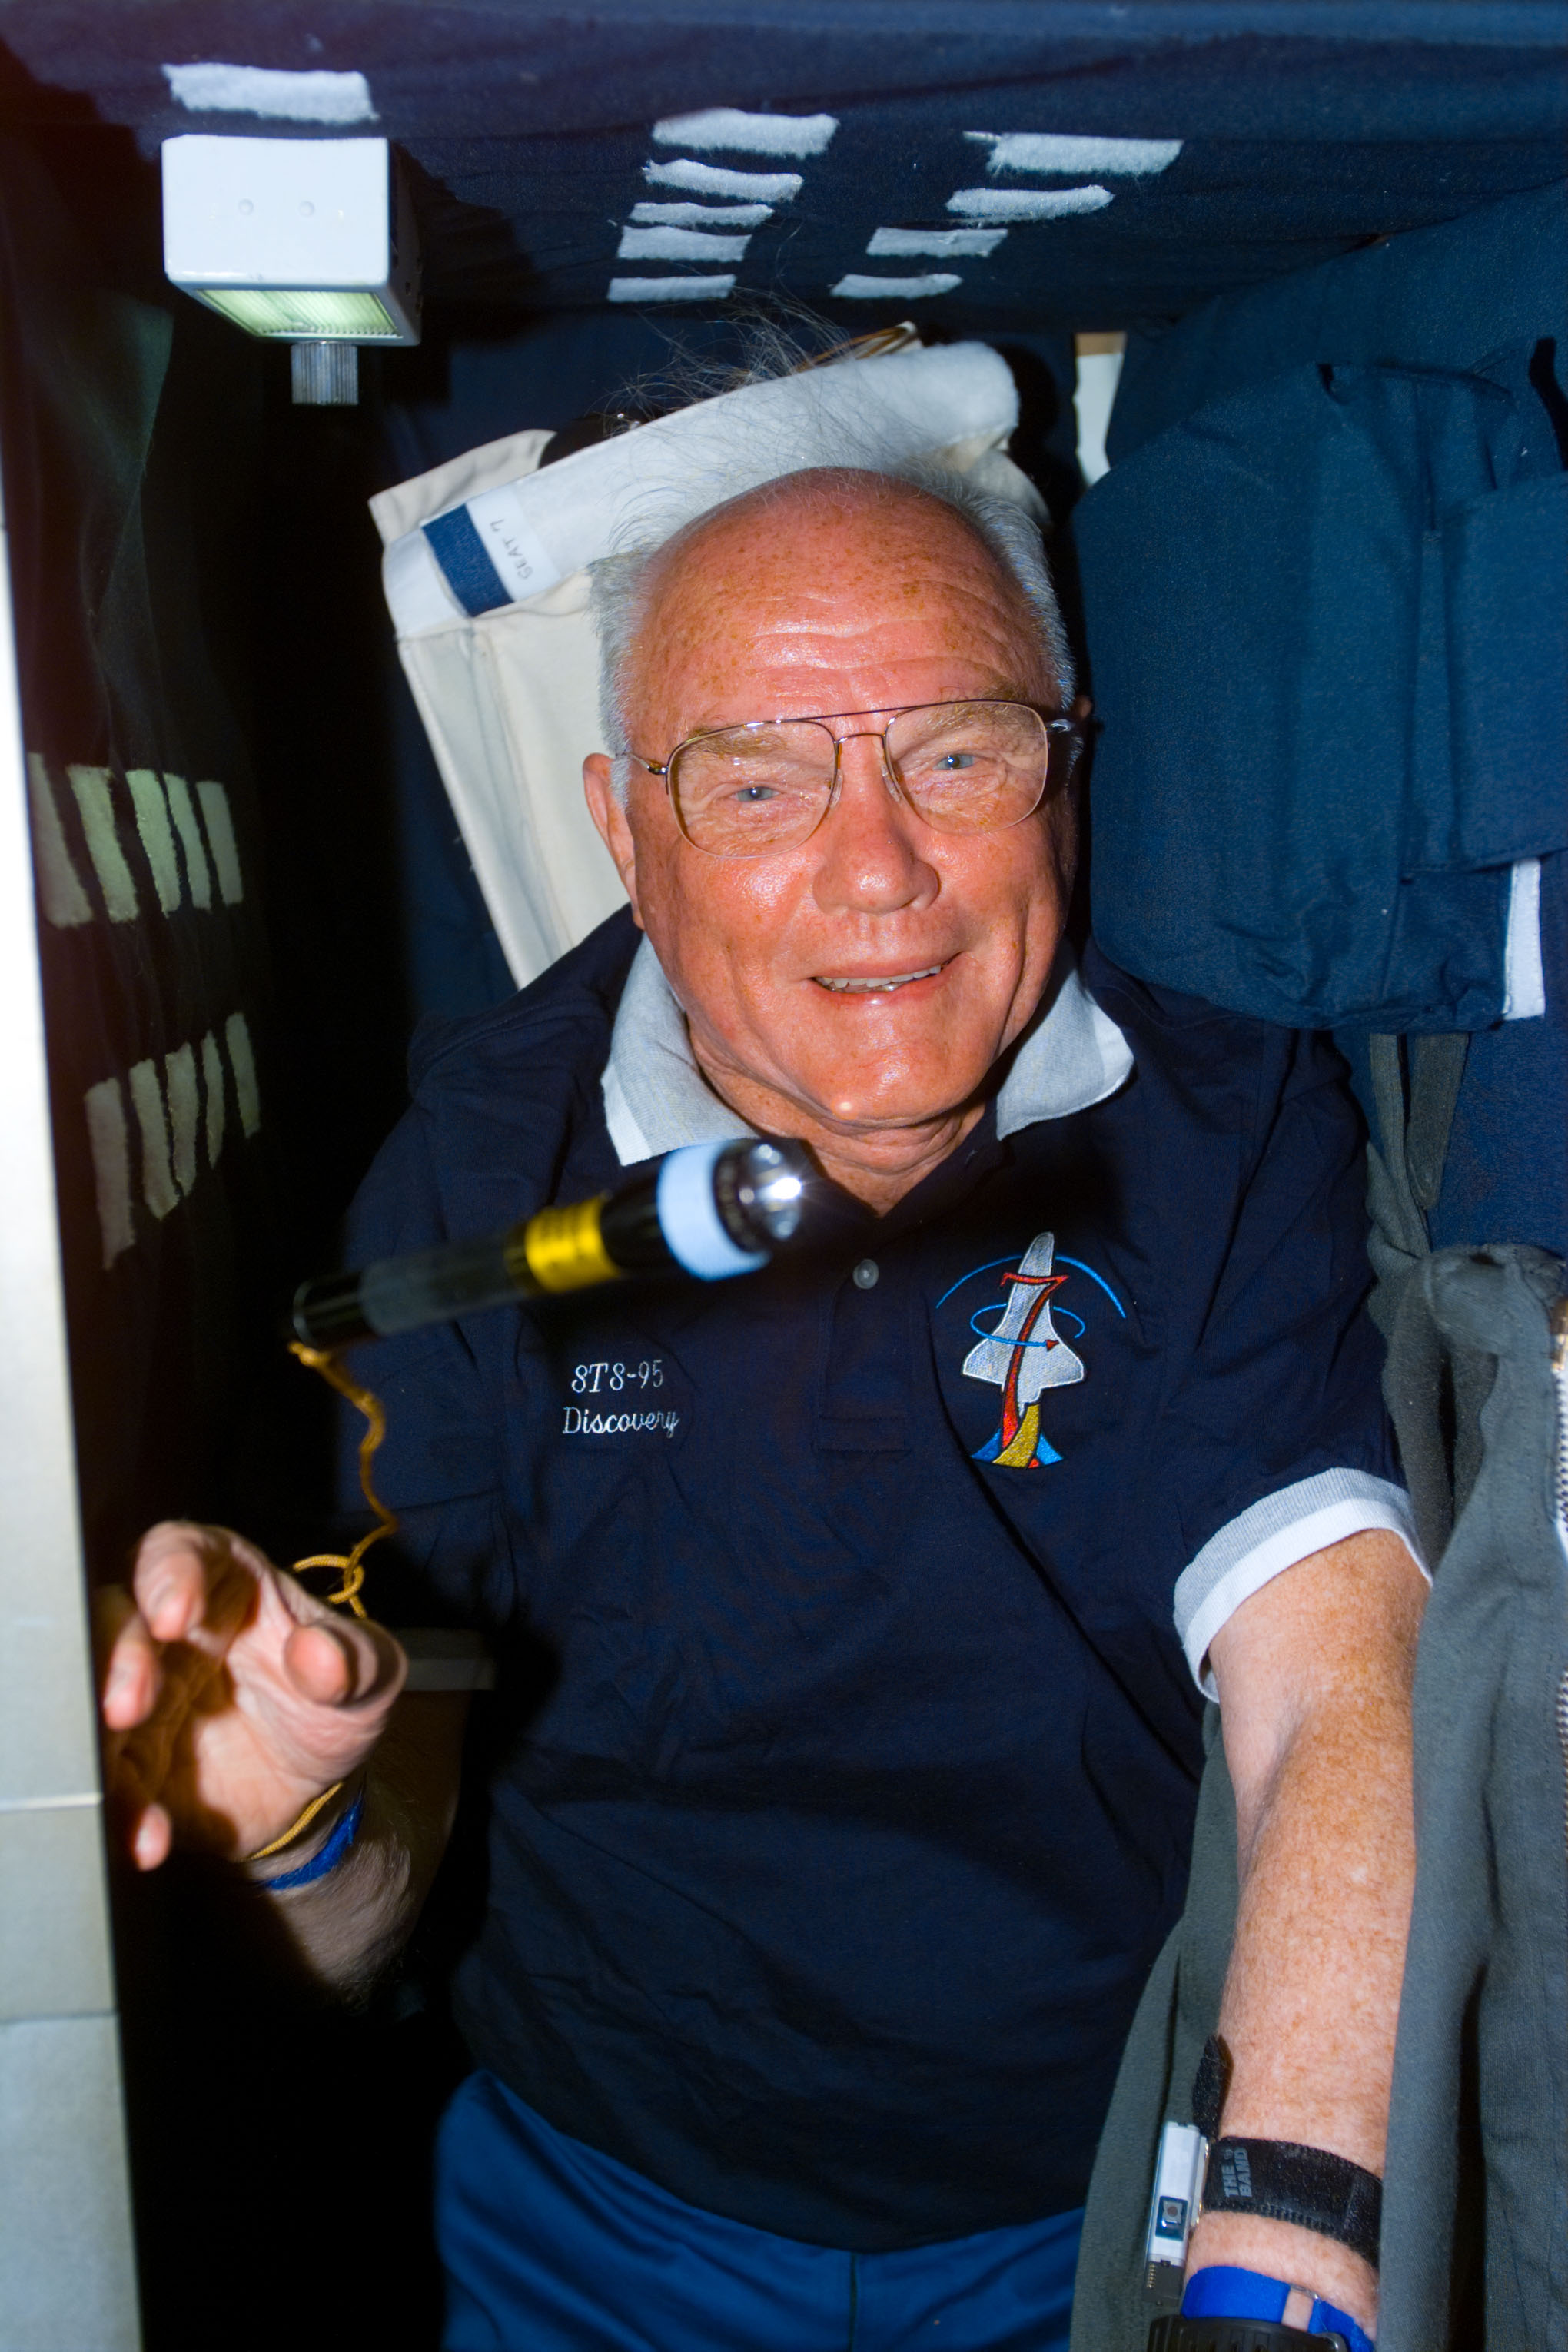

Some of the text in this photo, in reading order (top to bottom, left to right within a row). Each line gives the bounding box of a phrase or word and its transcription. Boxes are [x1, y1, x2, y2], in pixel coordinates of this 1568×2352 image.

[502, 537, 533, 580] SEAT
[571, 1360, 663, 1393] STS-95
[562, 1406, 680, 1438] Discovery
[1221, 2164, 1239, 2198] THE
[1234, 2146, 1253, 2198] BAND
